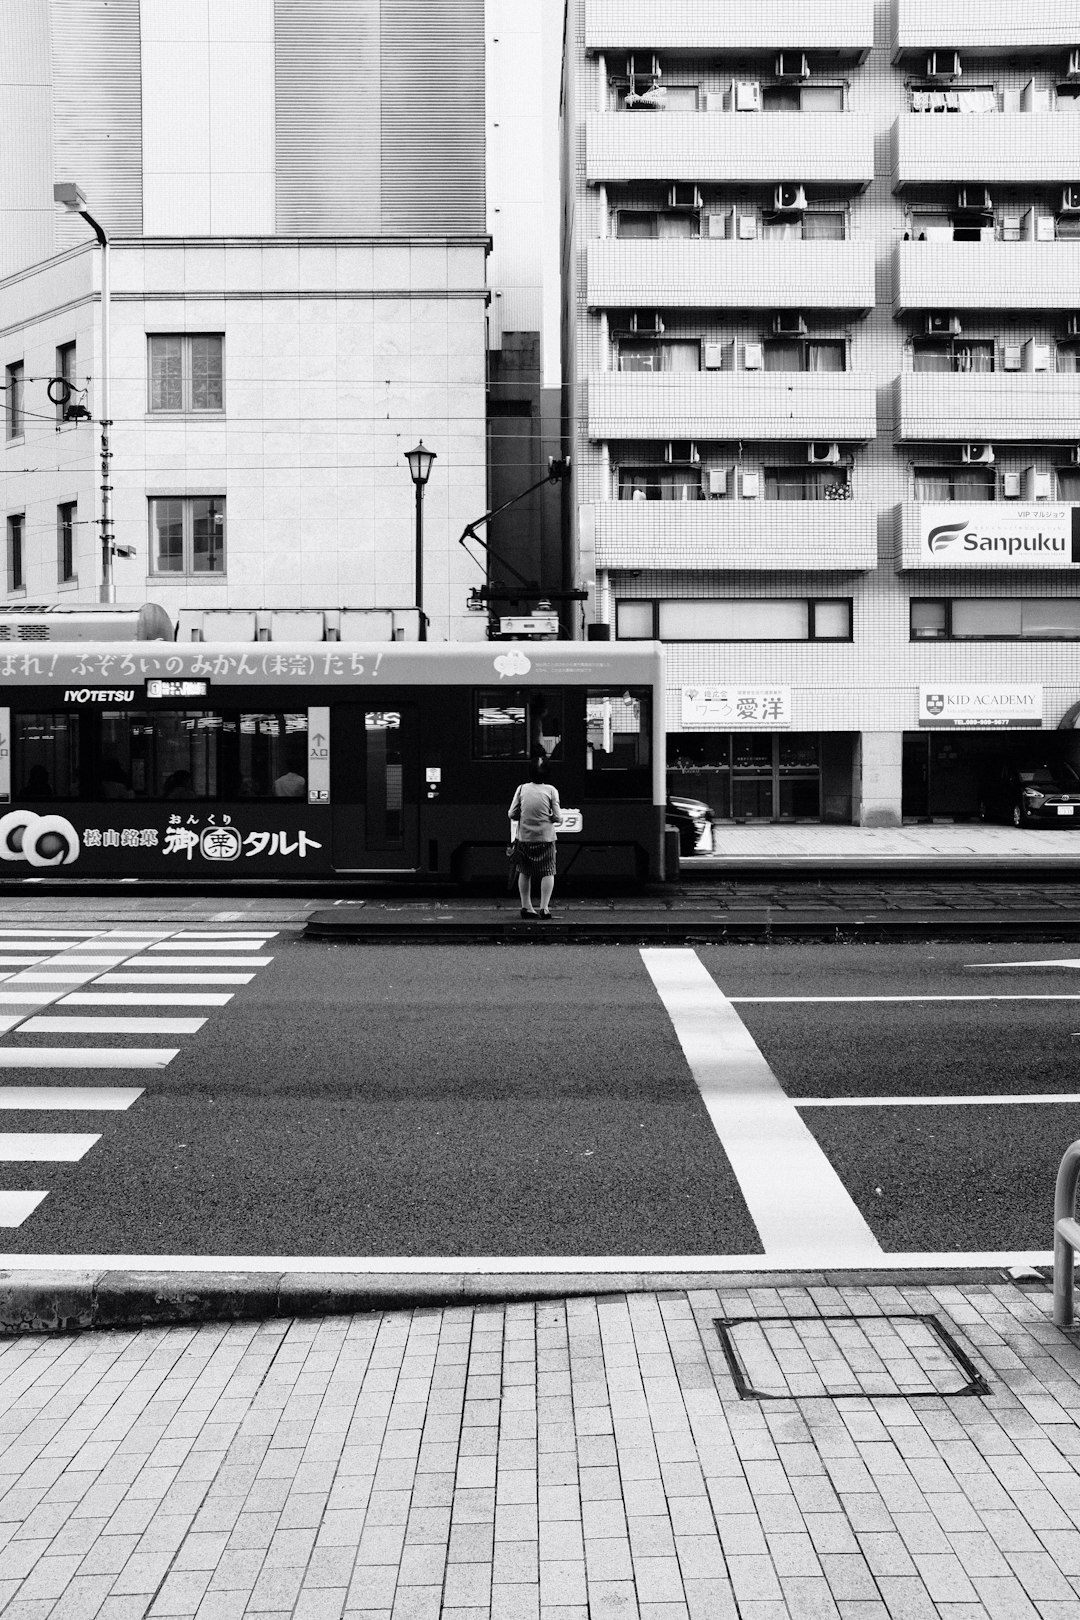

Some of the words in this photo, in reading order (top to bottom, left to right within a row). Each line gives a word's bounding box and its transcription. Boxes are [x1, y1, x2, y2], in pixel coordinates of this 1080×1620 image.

[964, 533, 1065, 555] Sanpuku
[64, 689, 134, 703] IYOTETSU
[947, 695, 970, 705] KID
[973, 695, 1035, 705] ACADEMY
[310, 748, 328, 757] 入口
[168, 814, 232, 825] おんくり
[83, 829, 159, 847] 松山銘菓
